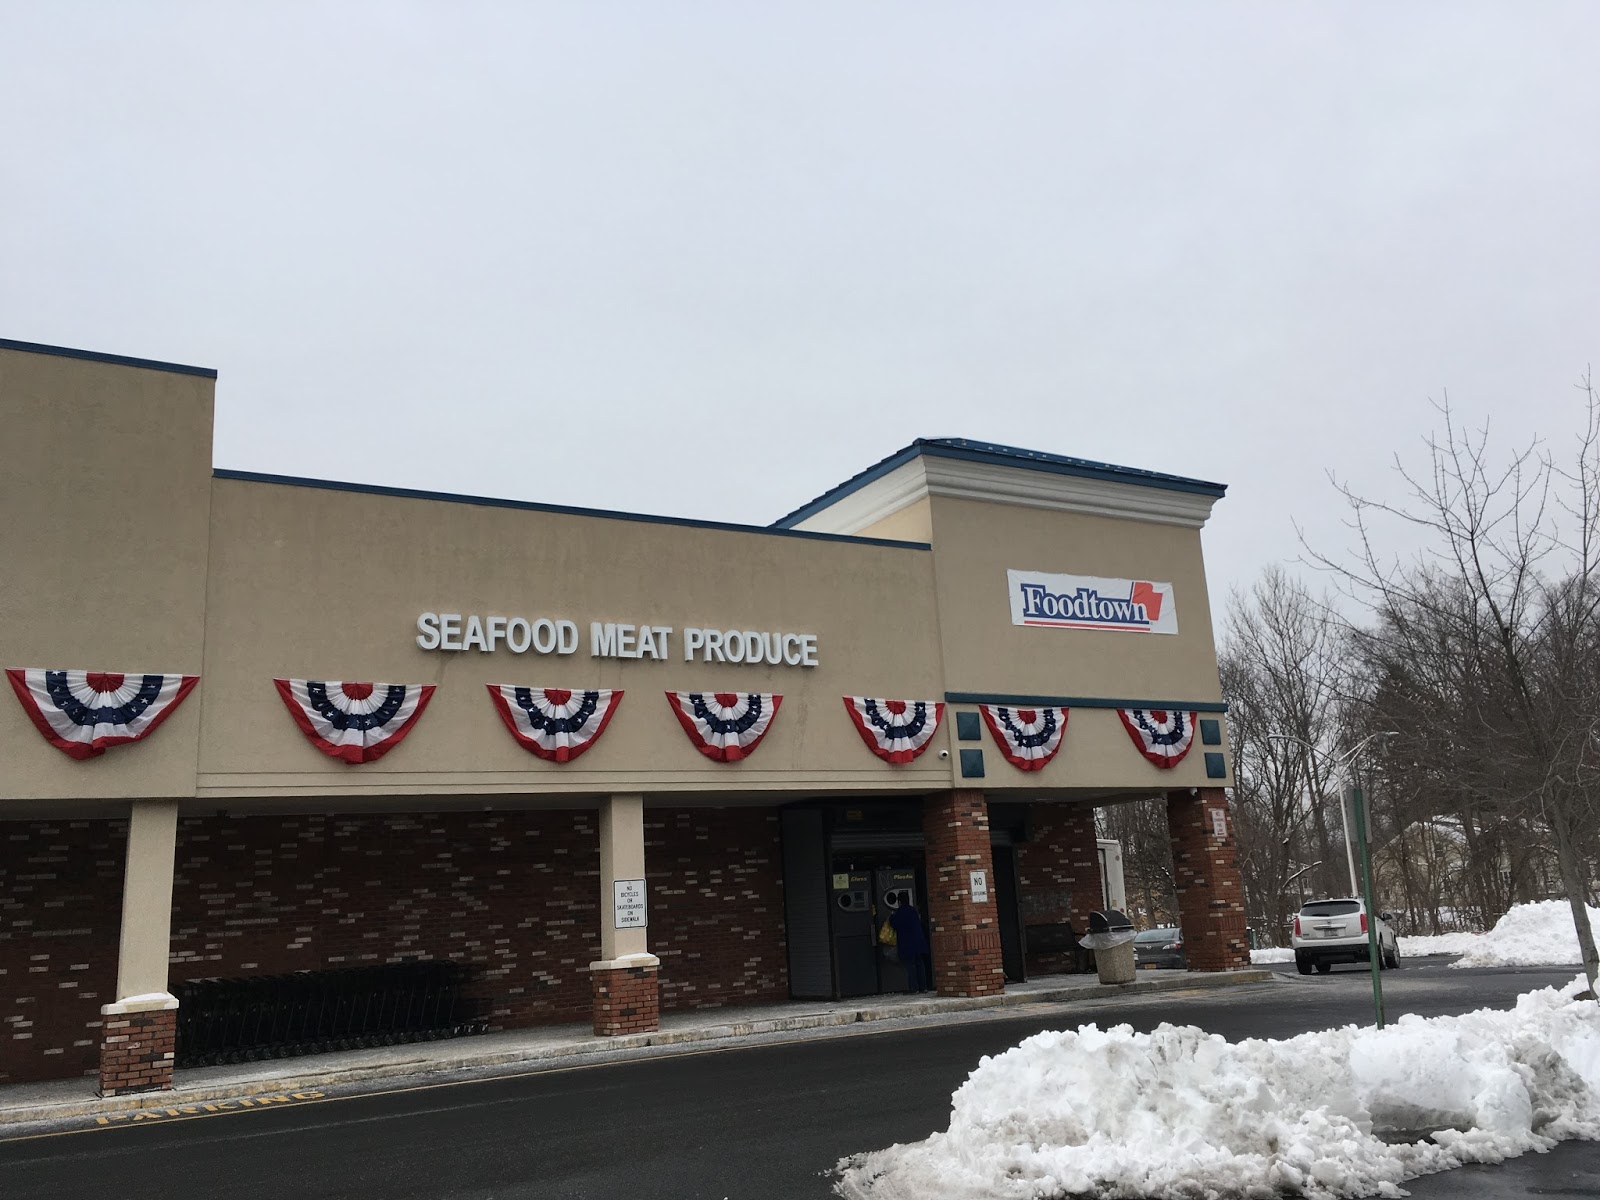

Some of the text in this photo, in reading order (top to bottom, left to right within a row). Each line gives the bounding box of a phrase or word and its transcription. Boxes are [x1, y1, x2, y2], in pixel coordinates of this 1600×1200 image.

[1022, 584, 1149, 623] Foodtown
[416, 612, 819, 667] SEAFOOD MEAT PRODUCE
[974, 877, 983, 886] NO
[95, 1090, 326, 1125] PARKING
